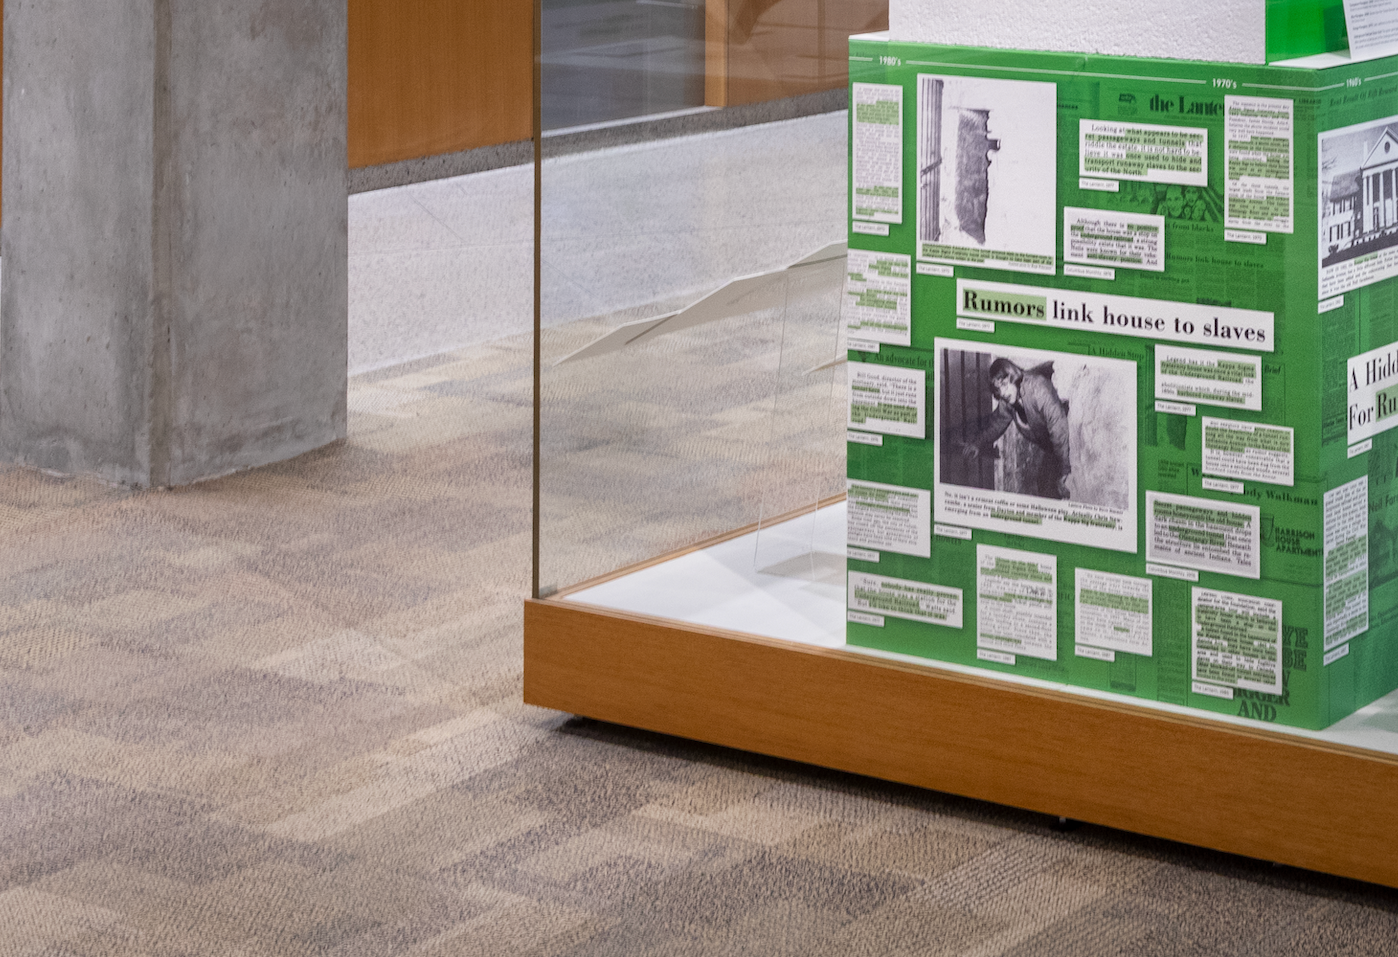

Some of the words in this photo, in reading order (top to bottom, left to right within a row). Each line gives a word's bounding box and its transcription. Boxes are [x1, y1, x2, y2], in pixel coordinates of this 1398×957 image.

[880, 56, 901, 66] 1980's
[1212, 78, 1237, 89] 1970's
[1150, 94, 1174, 113] the
[1179, 96, 1224, 116] Lante
[1092, 124, 1117, 134] Looking
[1144, 130, 1170, 138] appears
[1098, 135, 1140, 144] passageways
[1085, 158, 1114, 166] transport
[1117, 161, 1144, 169] runaway
[963, 290, 1046, 318] Rumors
[1053, 299, 1094, 324] link
[1103, 306, 1166, 332] house
[1173, 317, 1195, 336] to
[1203, 317, 1266, 343] slaves
[1180, 370, 1216, 380] Underground
[1349, 367, 1358, 391] A
[1349, 404, 1374, 430] For
[1275, 527, 1315, 539] HARRISON
[1276, 546, 1323, 557] APARTMENT
[1238, 700, 1277, 722] AND
